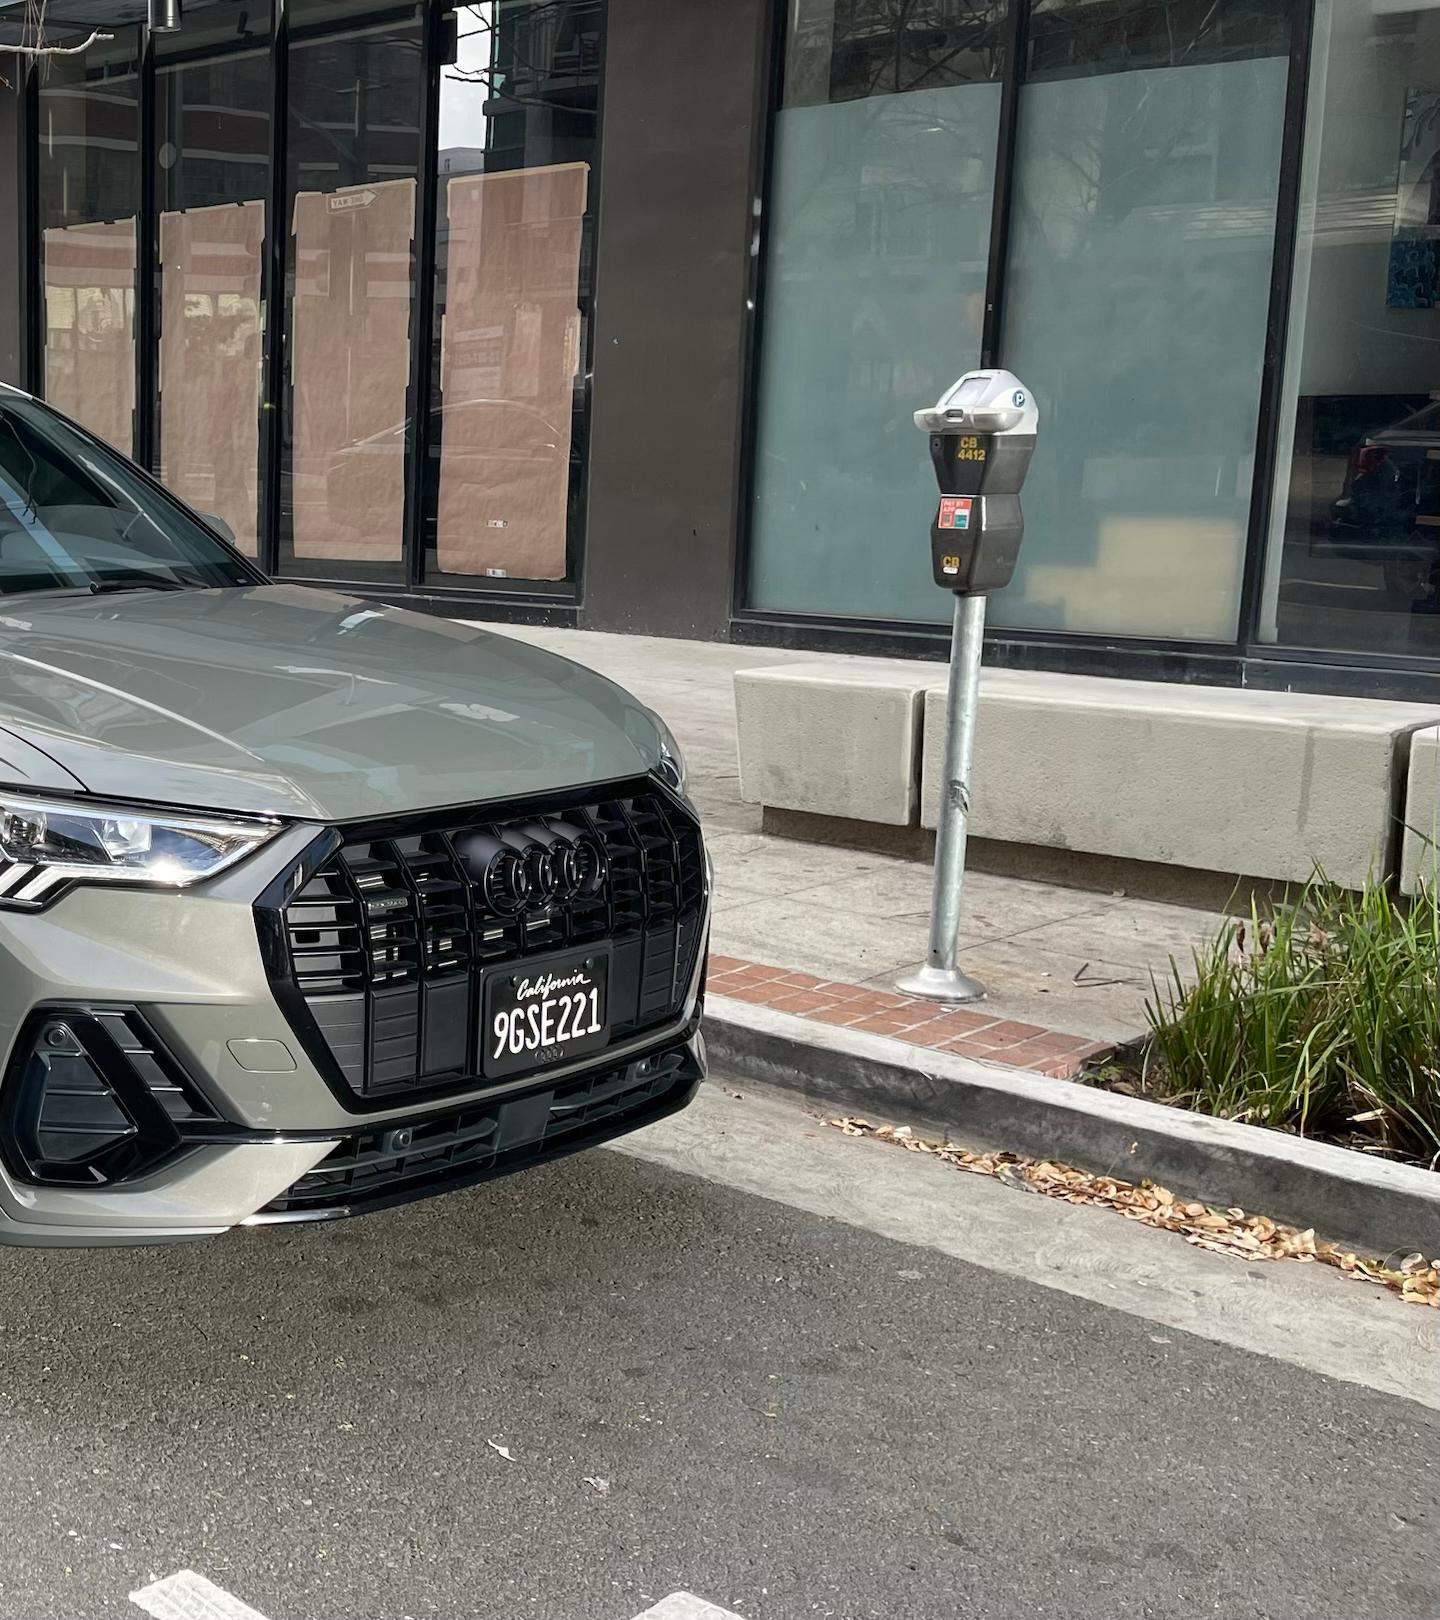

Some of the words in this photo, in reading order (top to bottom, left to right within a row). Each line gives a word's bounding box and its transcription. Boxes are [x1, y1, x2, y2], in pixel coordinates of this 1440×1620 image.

[960, 436, 977, 449] CB
[958, 449, 985, 461] 4412
[943, 556, 960, 568] CB
[517, 968, 591, 1001] California
[493, 988, 601, 1060] 9GSE221
